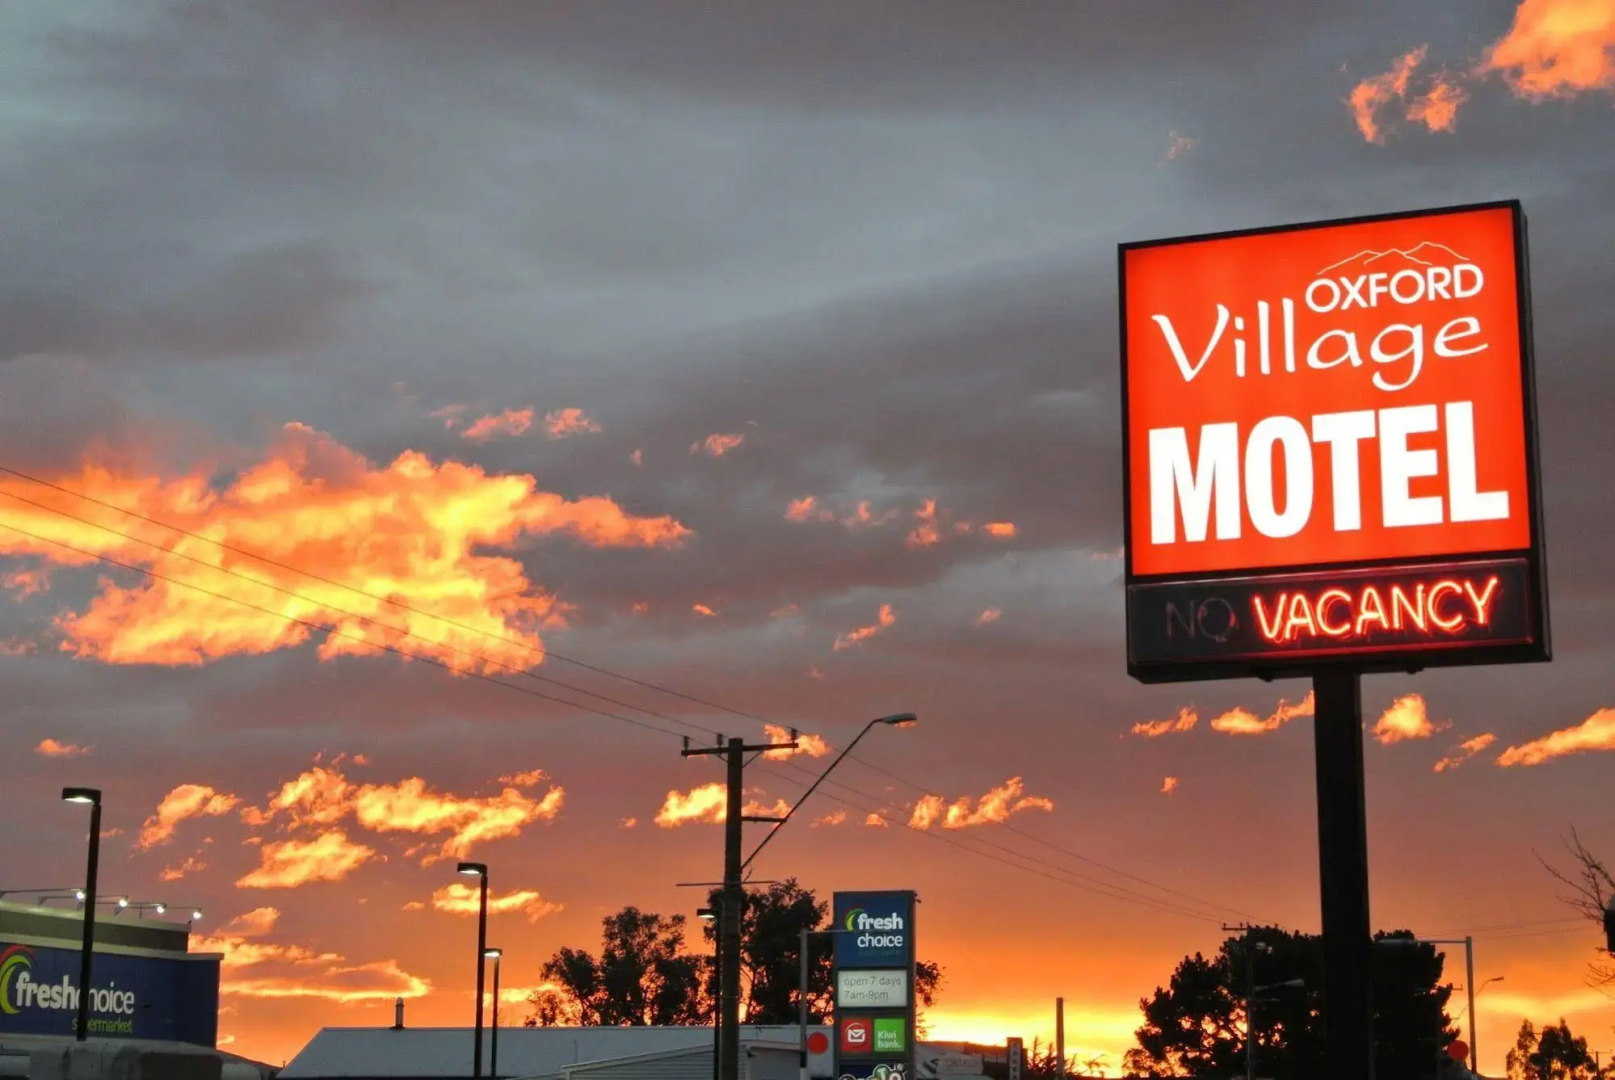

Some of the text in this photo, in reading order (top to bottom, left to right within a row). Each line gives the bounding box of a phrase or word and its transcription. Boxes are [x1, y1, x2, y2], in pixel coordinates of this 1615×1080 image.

[1305, 263, 1485, 314] OXFORD
[1151, 297, 1490, 392] Village
[1148, 401, 1511, 545] MOTEL
[1166, 576, 1499, 643] NO VACANCY
[857, 912, 903, 930] fresh
[857, 934, 903, 948] choice
[844, 976, 901, 988] open 7 days
[844, 990, 889, 1001] 7am-9pm
[72, 1017, 133, 1034] sermarket
[877, 1030, 897, 1039] Kiwi
